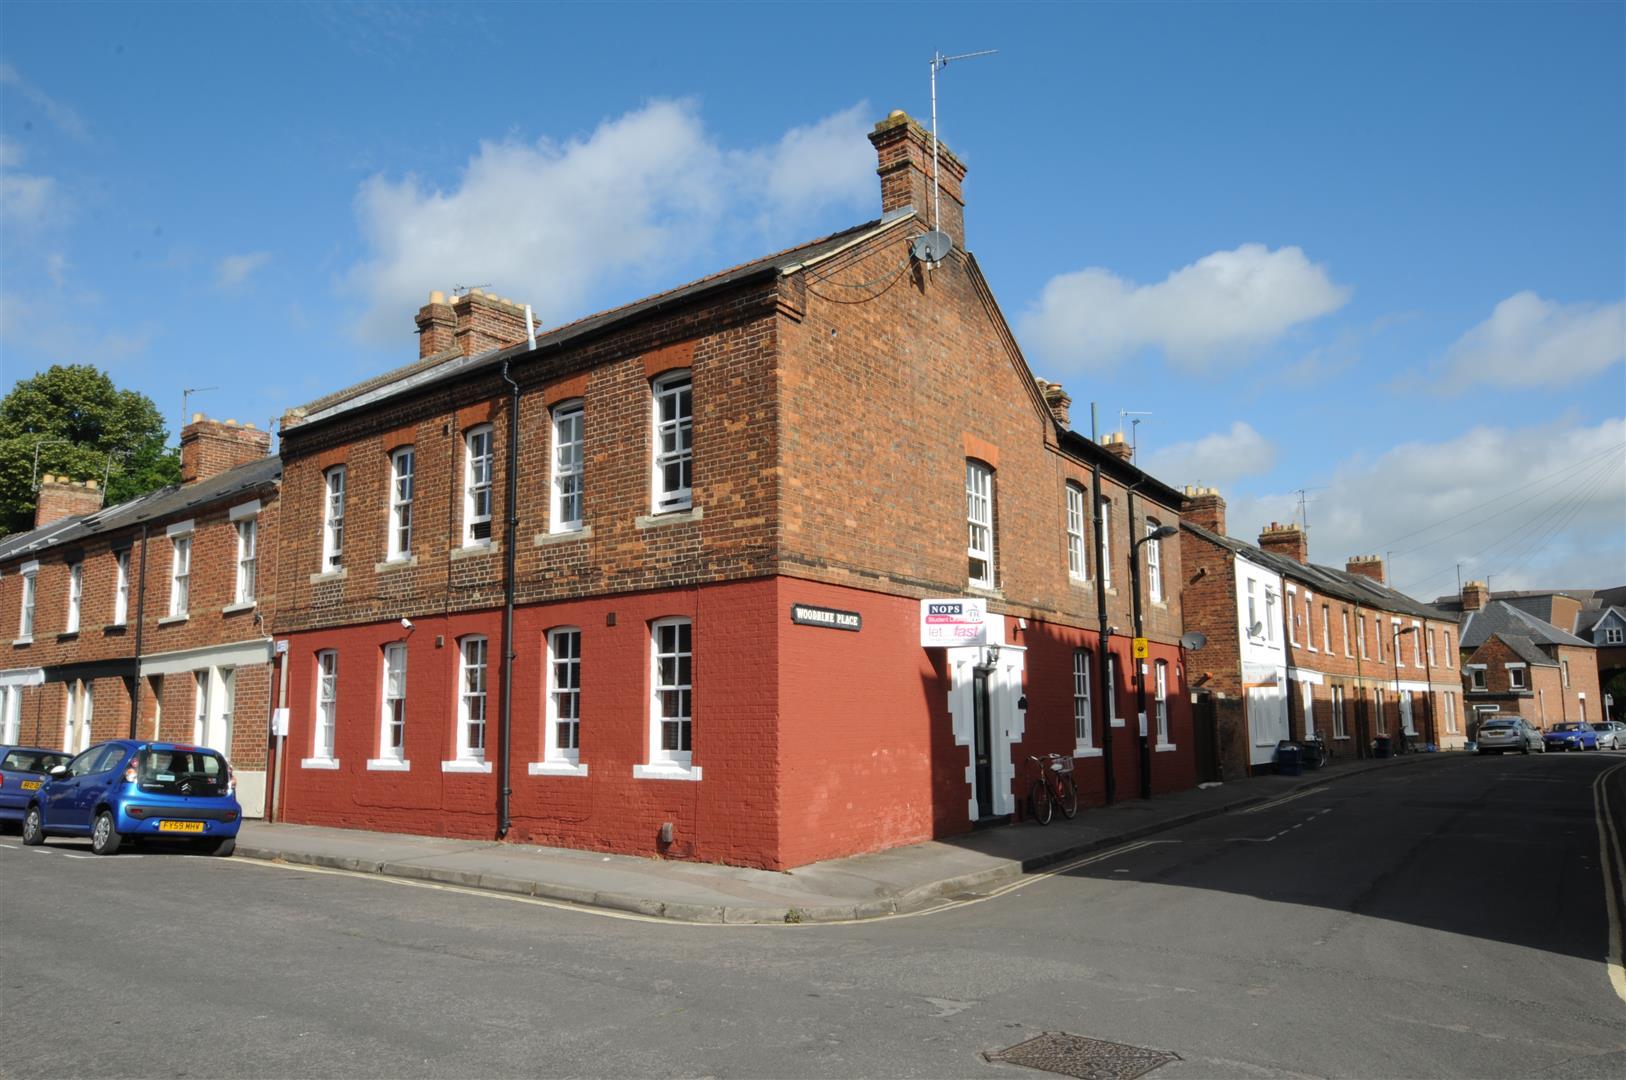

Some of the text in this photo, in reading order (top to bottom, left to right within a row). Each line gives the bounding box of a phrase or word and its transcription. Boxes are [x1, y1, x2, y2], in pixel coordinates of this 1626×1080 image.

[931, 604, 961, 614] NOPS
[795, 607, 859, 626] WOODBINE PLACE
[928, 625, 979, 638] let fast
